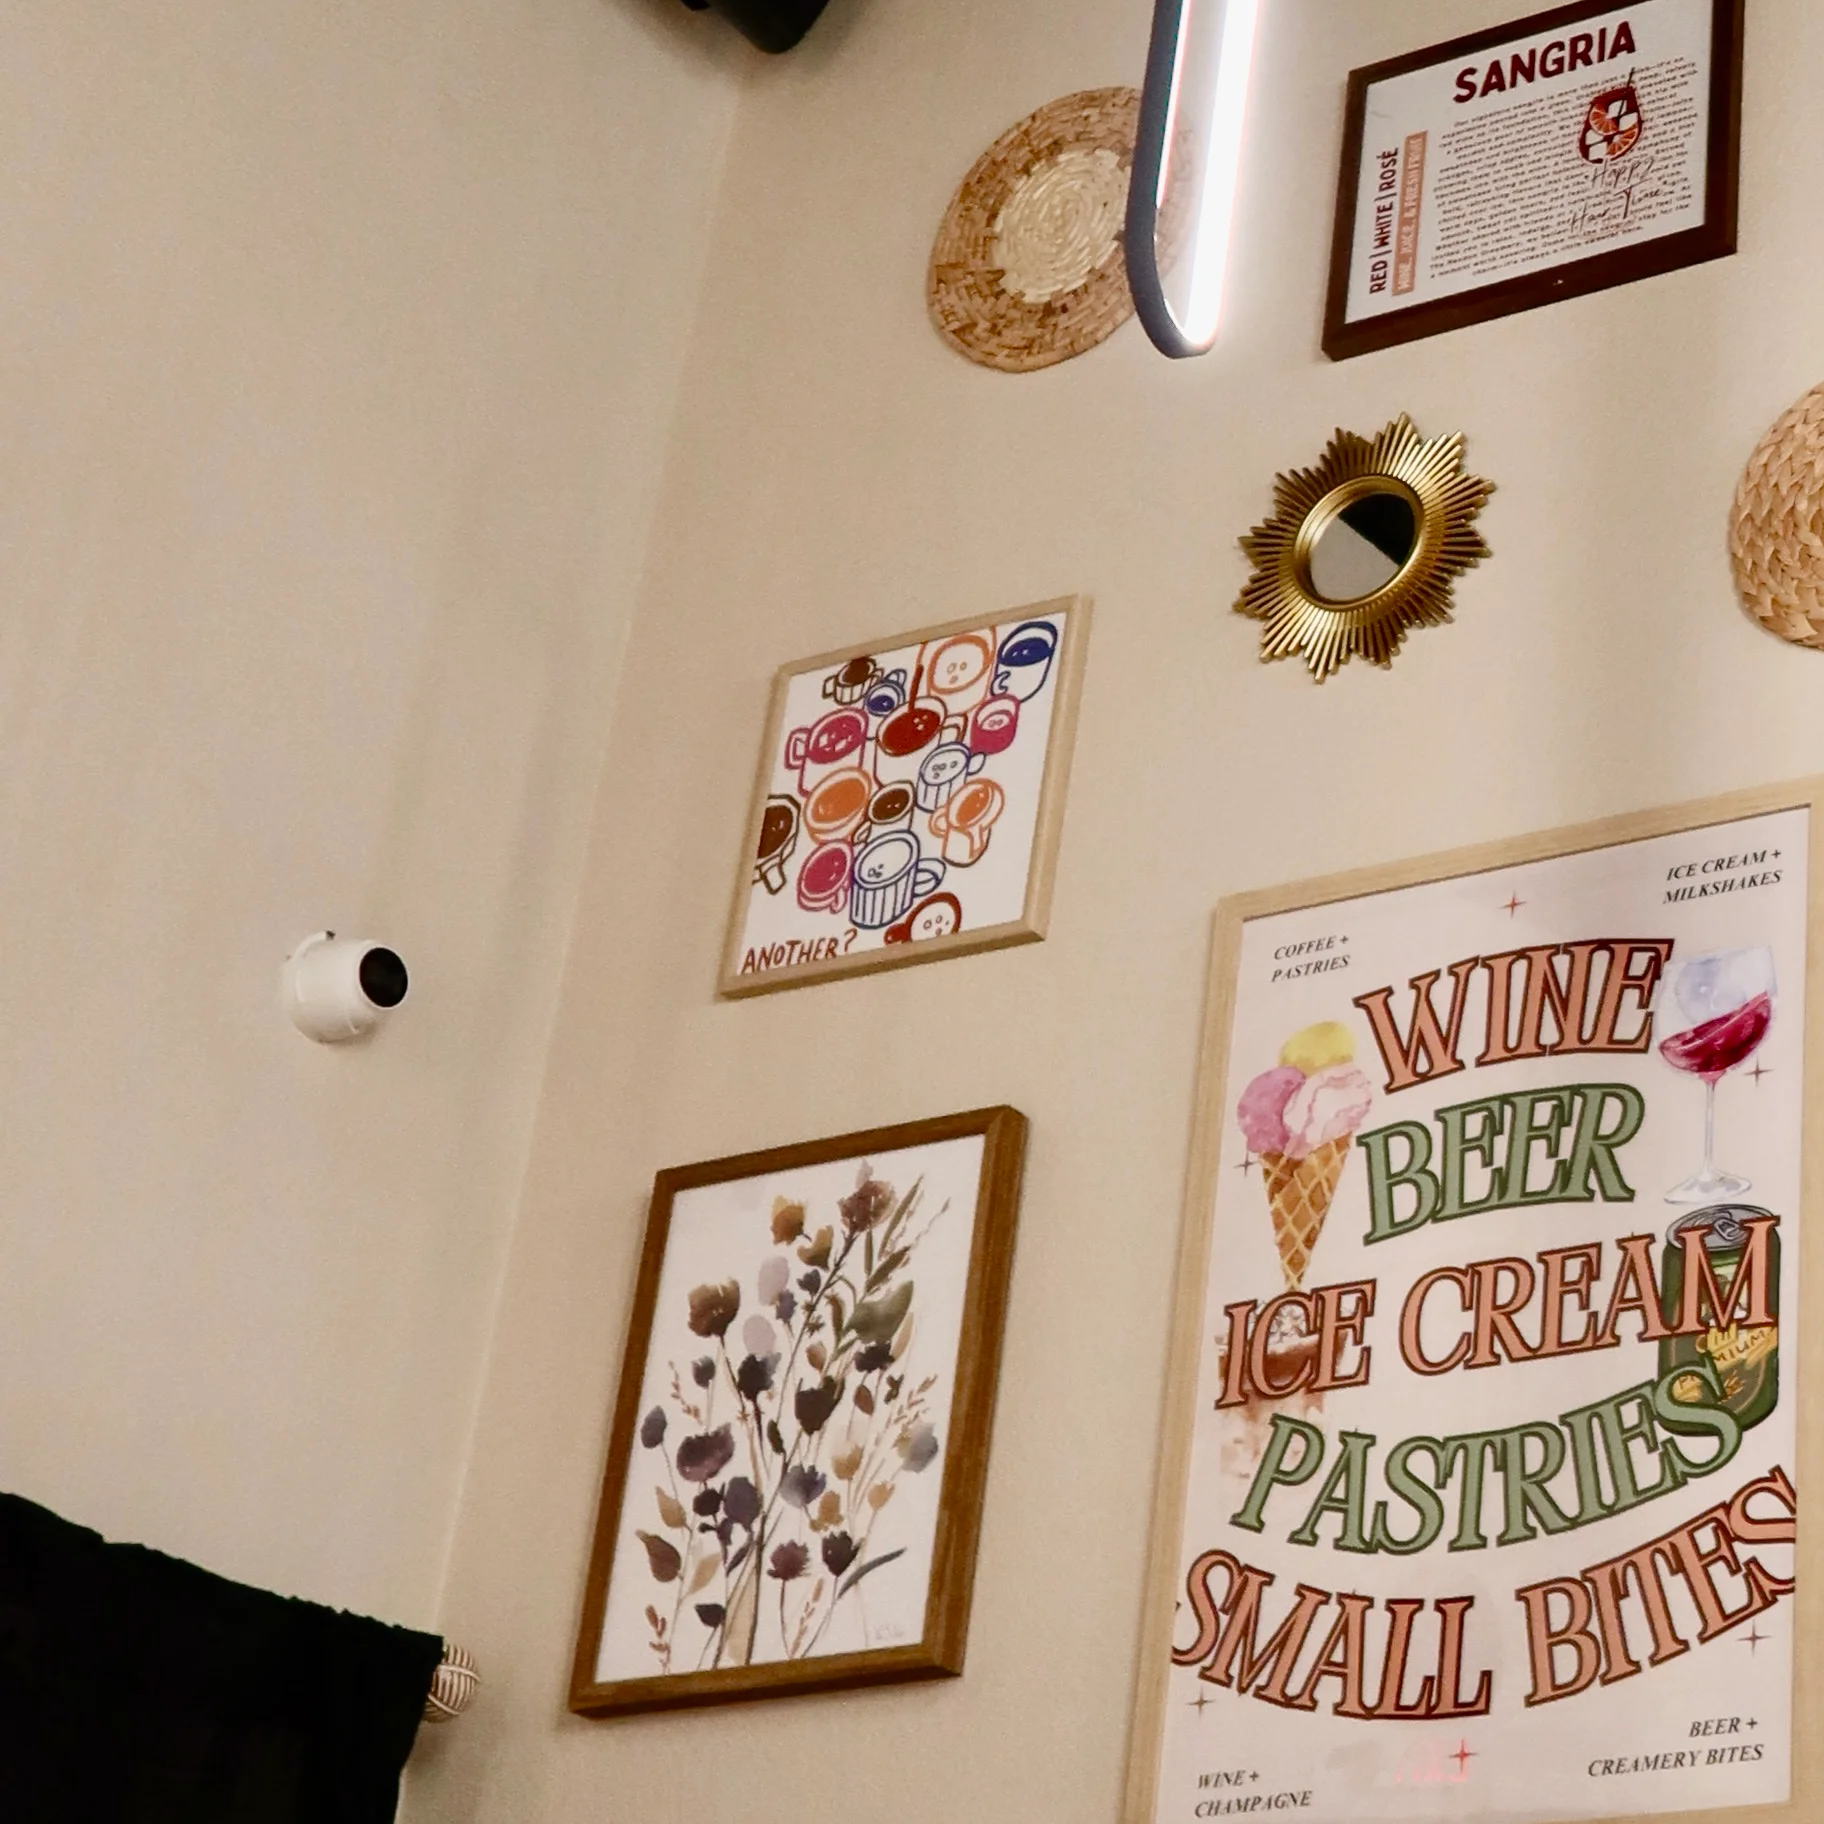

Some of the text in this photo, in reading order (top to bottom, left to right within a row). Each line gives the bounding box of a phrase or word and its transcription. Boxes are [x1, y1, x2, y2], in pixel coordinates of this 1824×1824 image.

[1453, 20, 1636, 103] SANGRIA
[1373, 201, 1394, 250] WHITE
[1369, 259, 1388, 295] RED
[1666, 863, 1698, 881] ICE
[1701, 850, 1767, 874] CREAM
[1662, 870, 1783, 904] MILKSHAKES
[1273, 935, 1336, 960] COFFEE
[1271, 954, 1351, 983] PASTRIES
[1353, 937, 1674, 1093] WINE
[1356, 1082, 1644, 1245] BEER
[1214, 1216, 1781, 1409] ICE CREAM
[1230, 1359, 1743, 1555] PASTRIES
[1171, 1465, 1796, 1720] SMALL BITES
[1688, 1717, 1741, 1738] BEER
[1588, 1743, 1764, 1777] CREAMERY BITES
[1198, 1770, 1246, 1788] WINE
[1194, 1790, 1313, 1818] CHAMPAGNE
